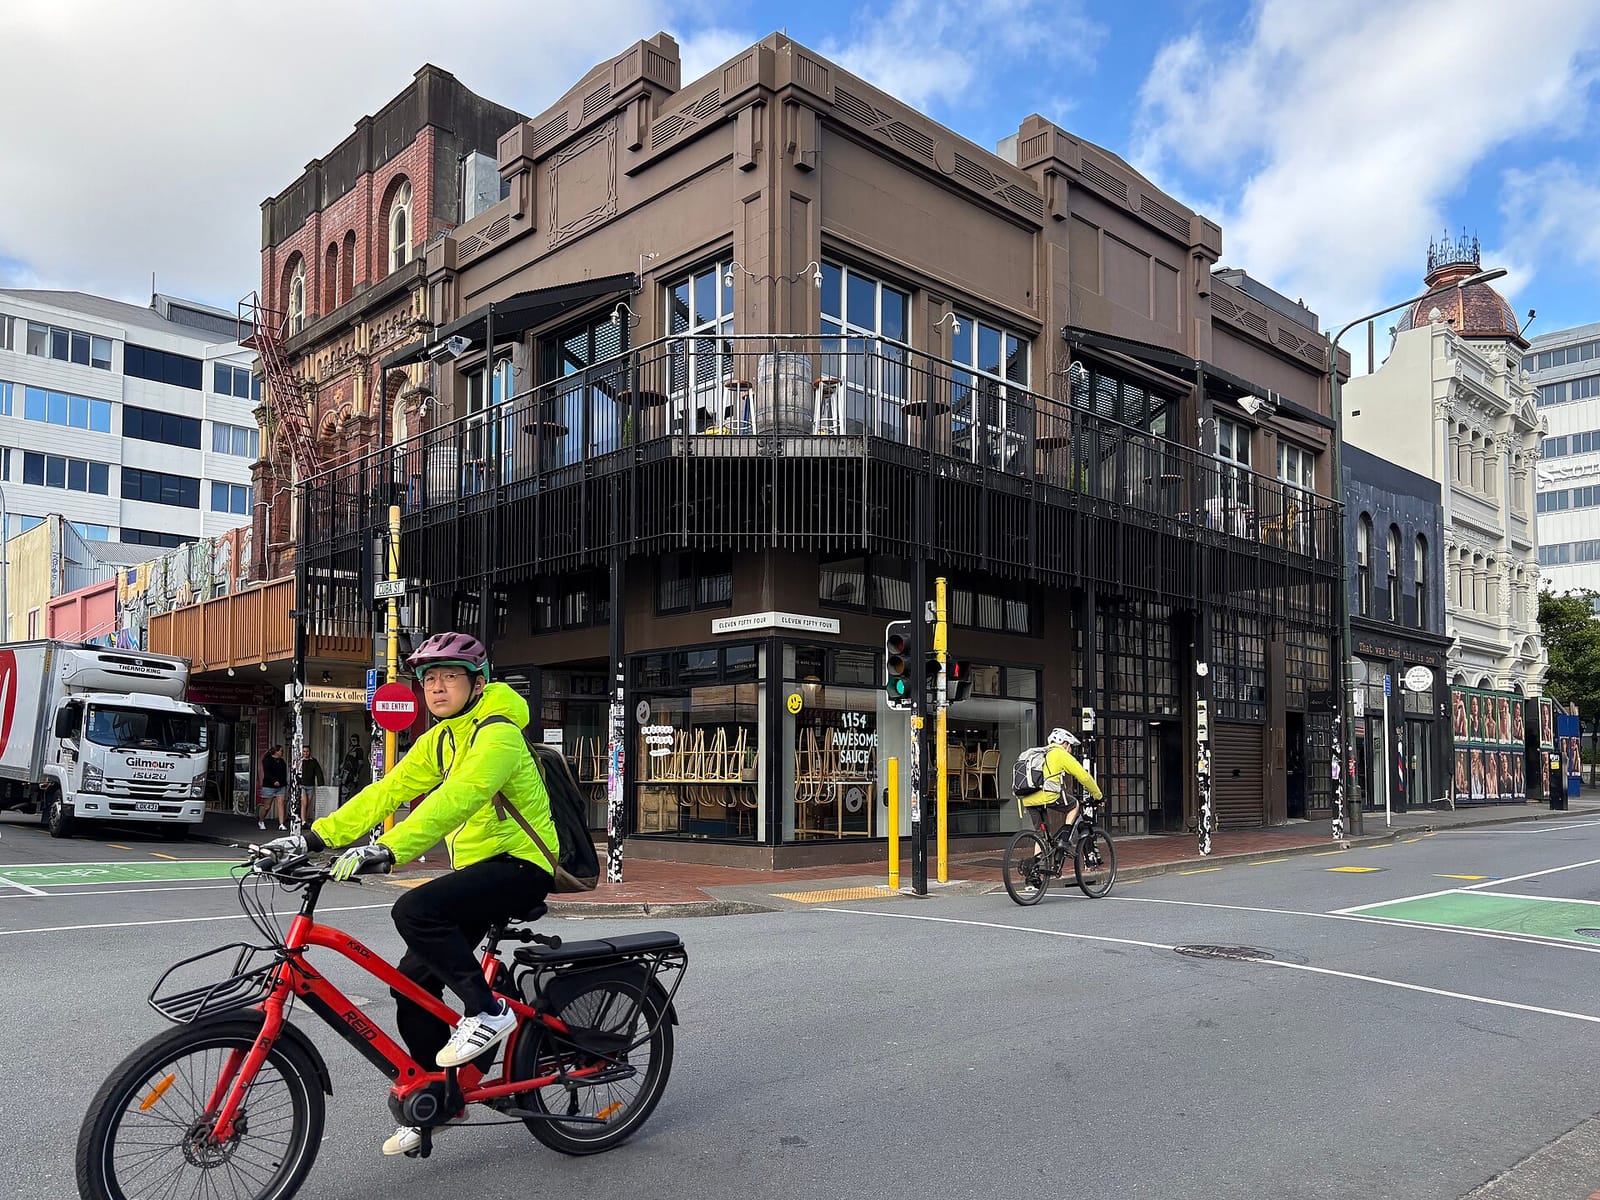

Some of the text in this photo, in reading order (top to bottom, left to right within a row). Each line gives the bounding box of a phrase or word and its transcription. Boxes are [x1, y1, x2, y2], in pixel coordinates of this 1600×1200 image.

[718, 616, 766, 629] ELEVEN FIFTY FOUR
[781, 616, 833, 629] ELEVEN FIFTY FOUR
[118, 664, 161, 675] THERMO KING
[305, 688, 335, 700] Hunters
[336, 690, 342, 700] &
[381, 702, 409, 711] NO ENTRY
[841, 712, 867, 729] 1154
[832, 732, 879, 747] AWESOME
[126, 757, 175, 770] Gilmours
[840, 750, 869, 764] SAUCE
[341, 1010, 378, 1041] REID
